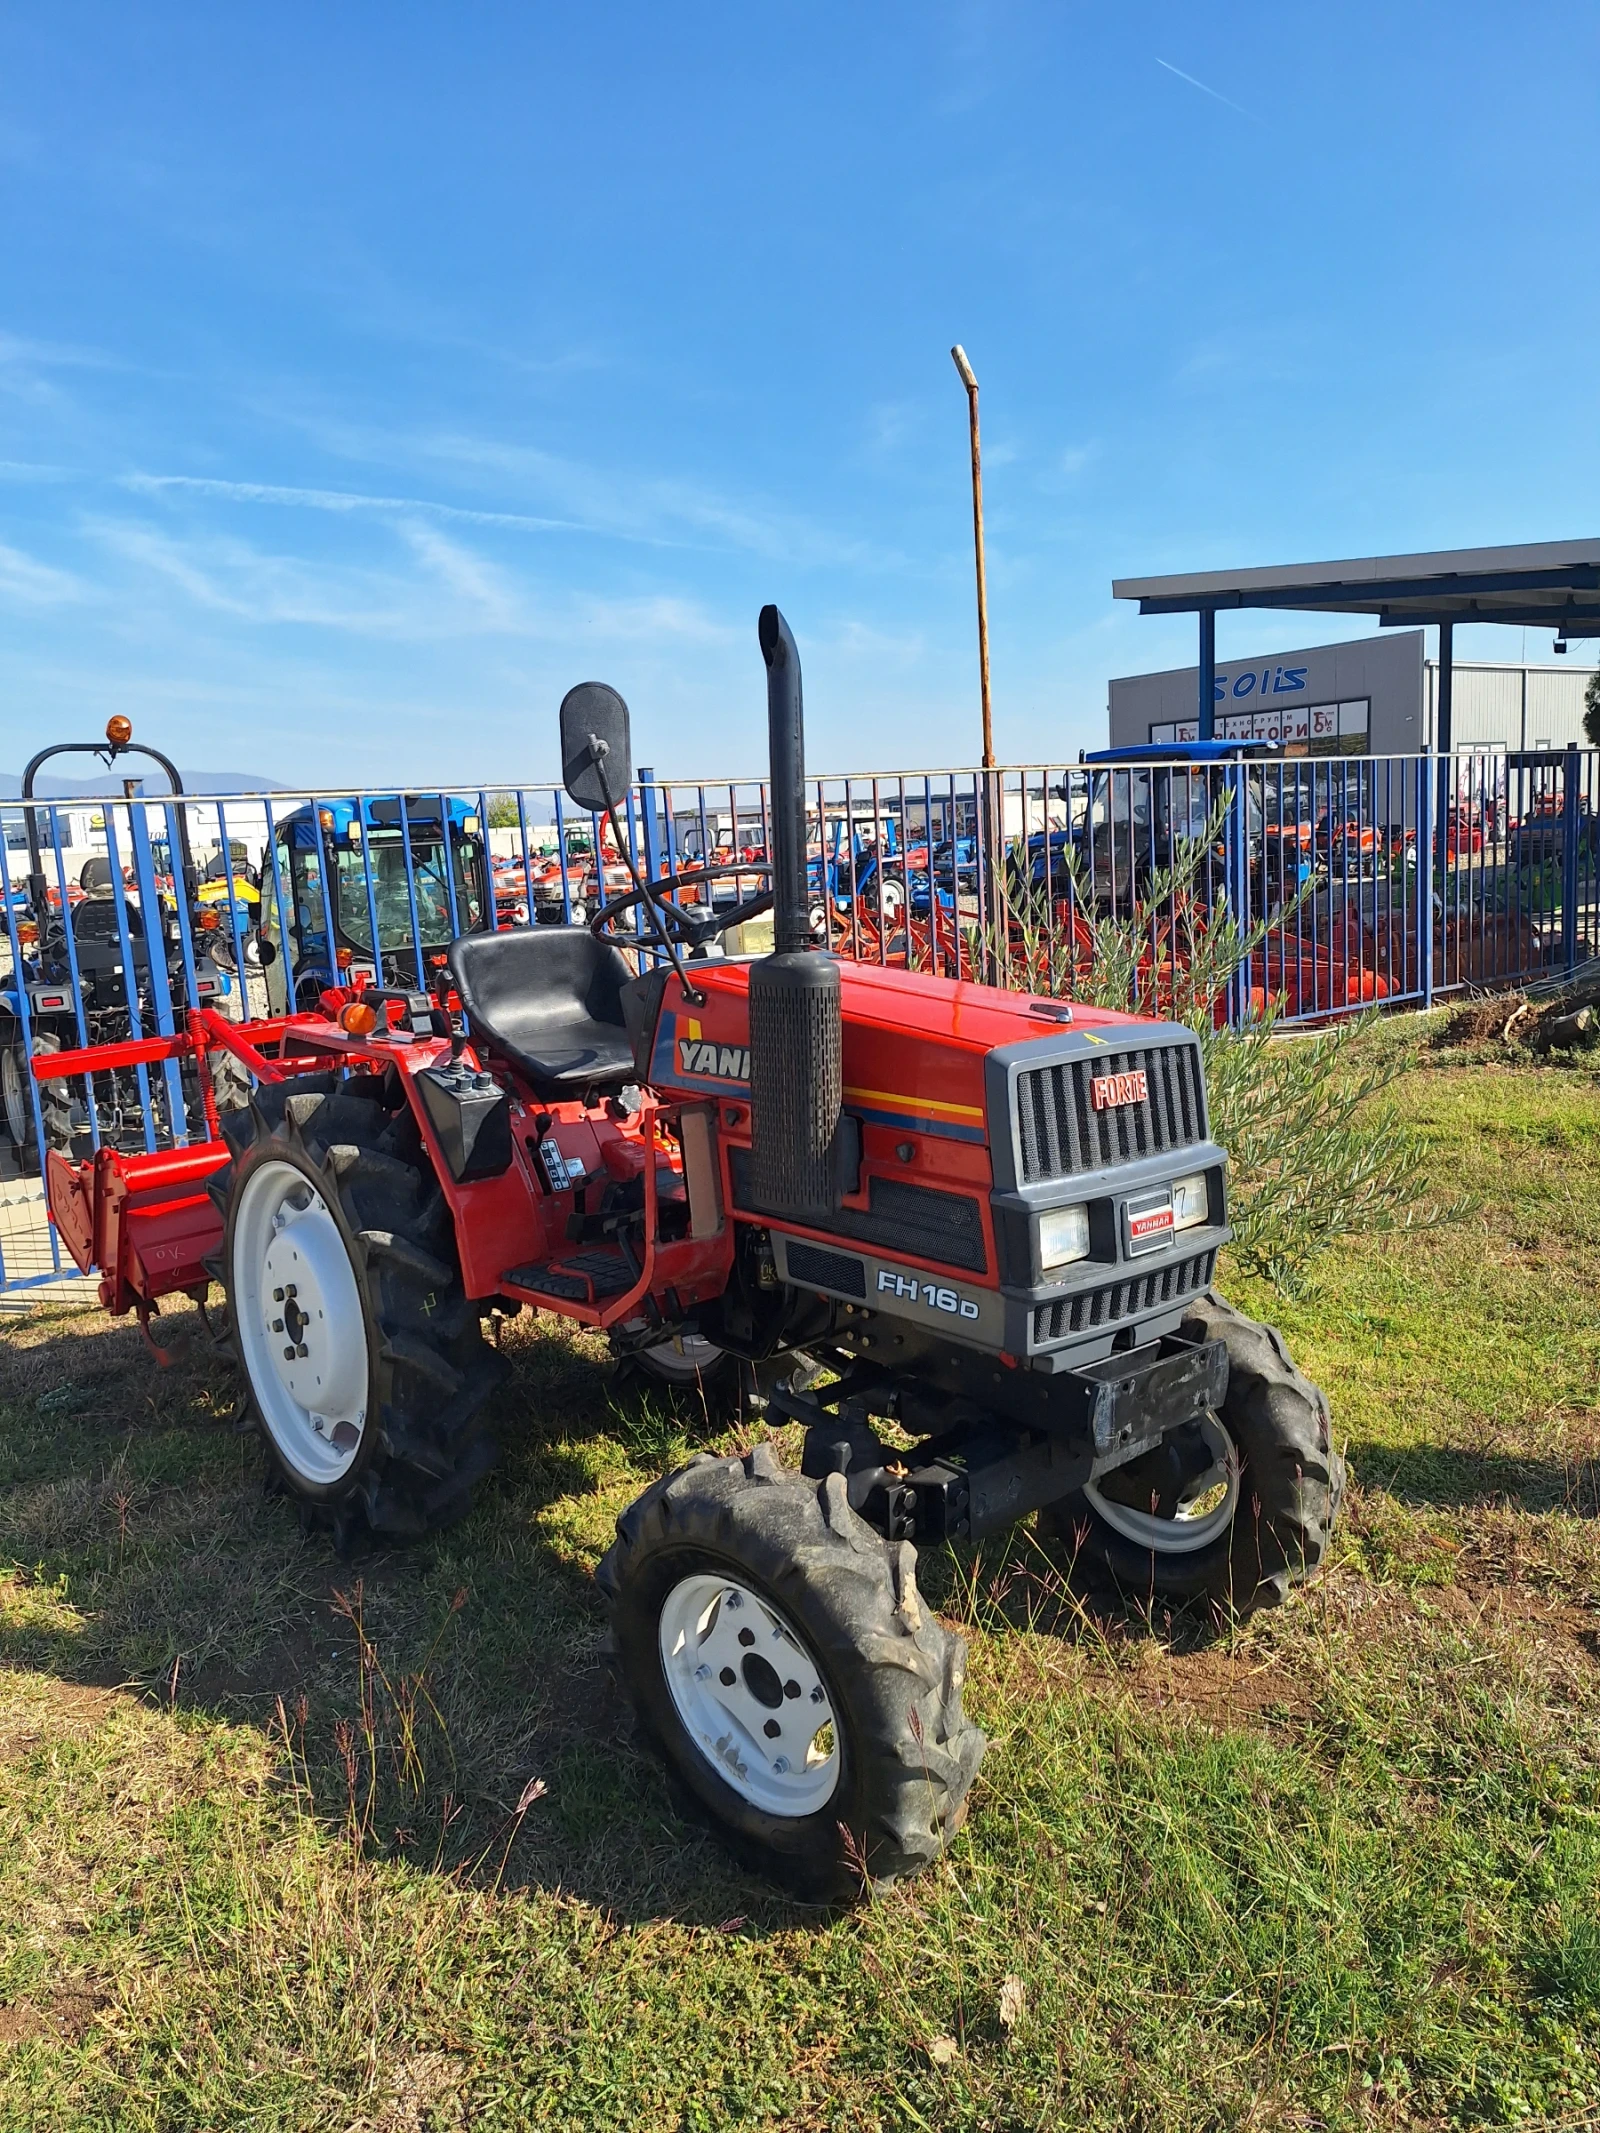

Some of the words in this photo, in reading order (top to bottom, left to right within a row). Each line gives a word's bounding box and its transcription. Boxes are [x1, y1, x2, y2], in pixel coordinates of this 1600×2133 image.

[1214, 723, 1308, 741] АКТОРИ
[679, 1041, 751, 1079] YAN
[1093, 1070, 1148, 1110] FORTE
[1135, 1215, 1170, 1232] YANMAR
